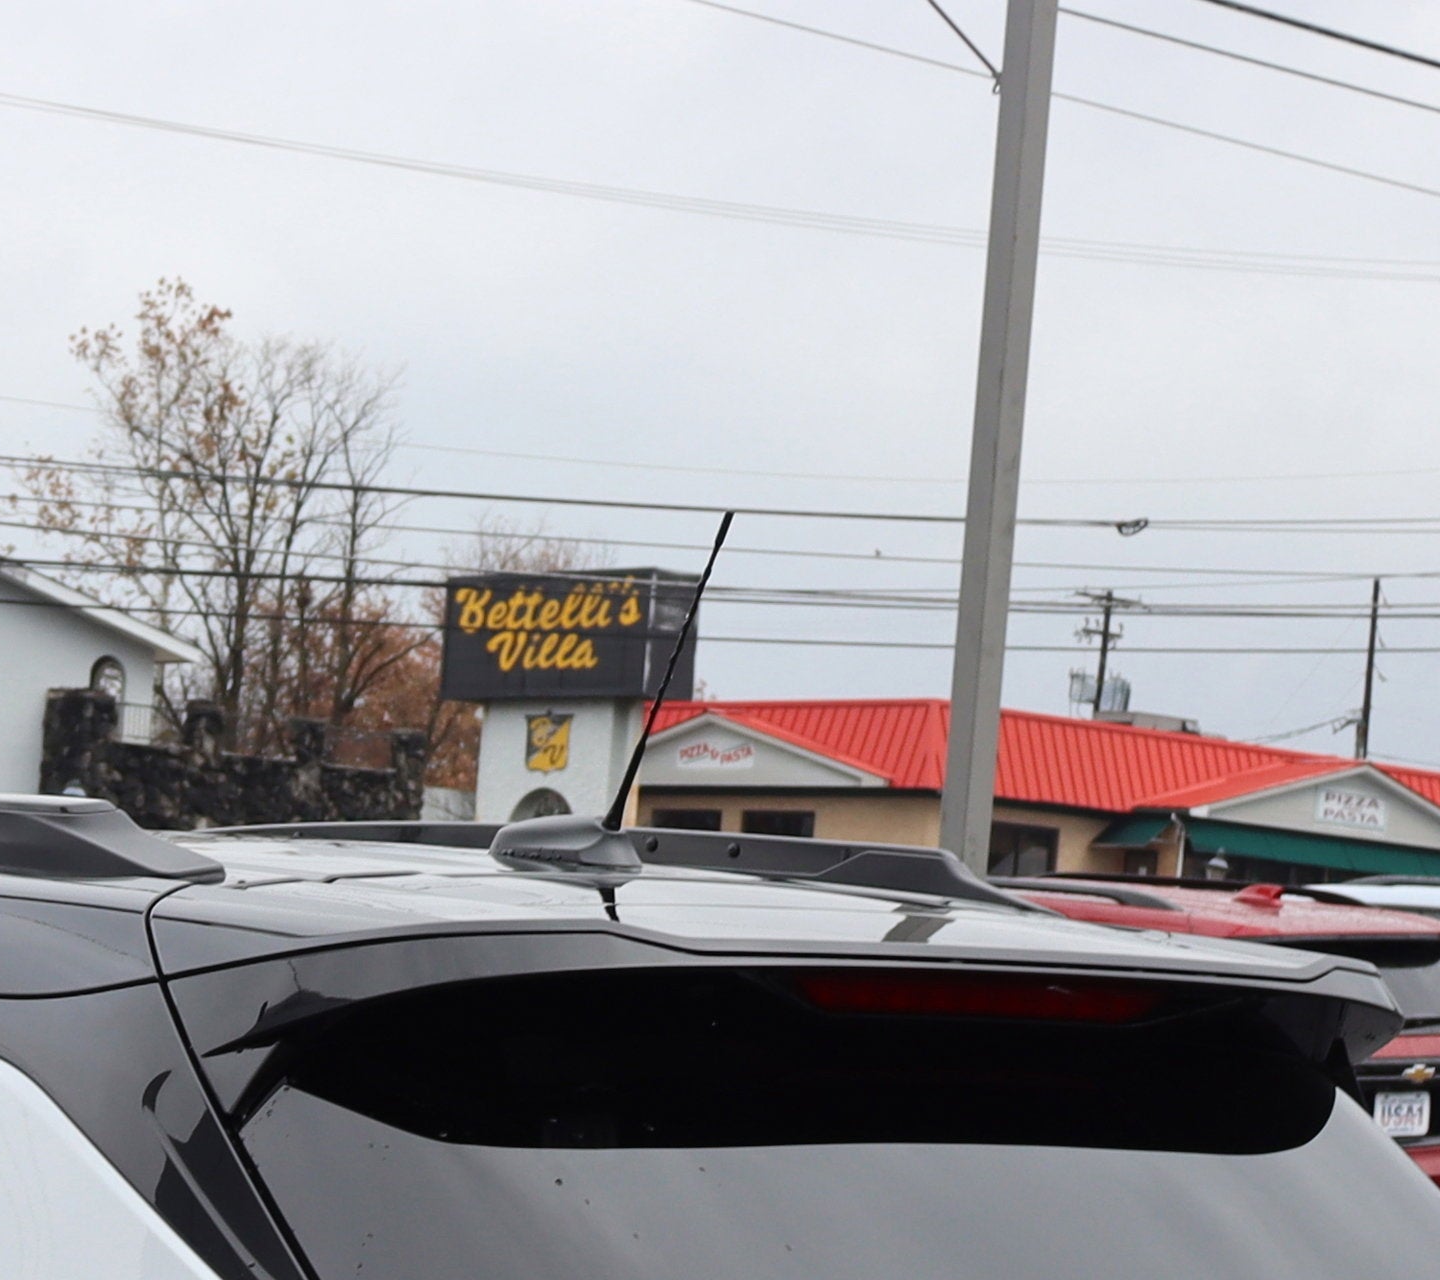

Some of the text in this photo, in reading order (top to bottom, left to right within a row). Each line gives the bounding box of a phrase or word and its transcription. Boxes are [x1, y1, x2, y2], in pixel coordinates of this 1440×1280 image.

[455, 576, 642, 633] Bettelli's
[486, 630, 599, 671] Villa
[680, 742, 709, 760] PIZZA
[1324, 791, 1380, 809] PIZZA
[1323, 807, 1379, 825] PASTA
